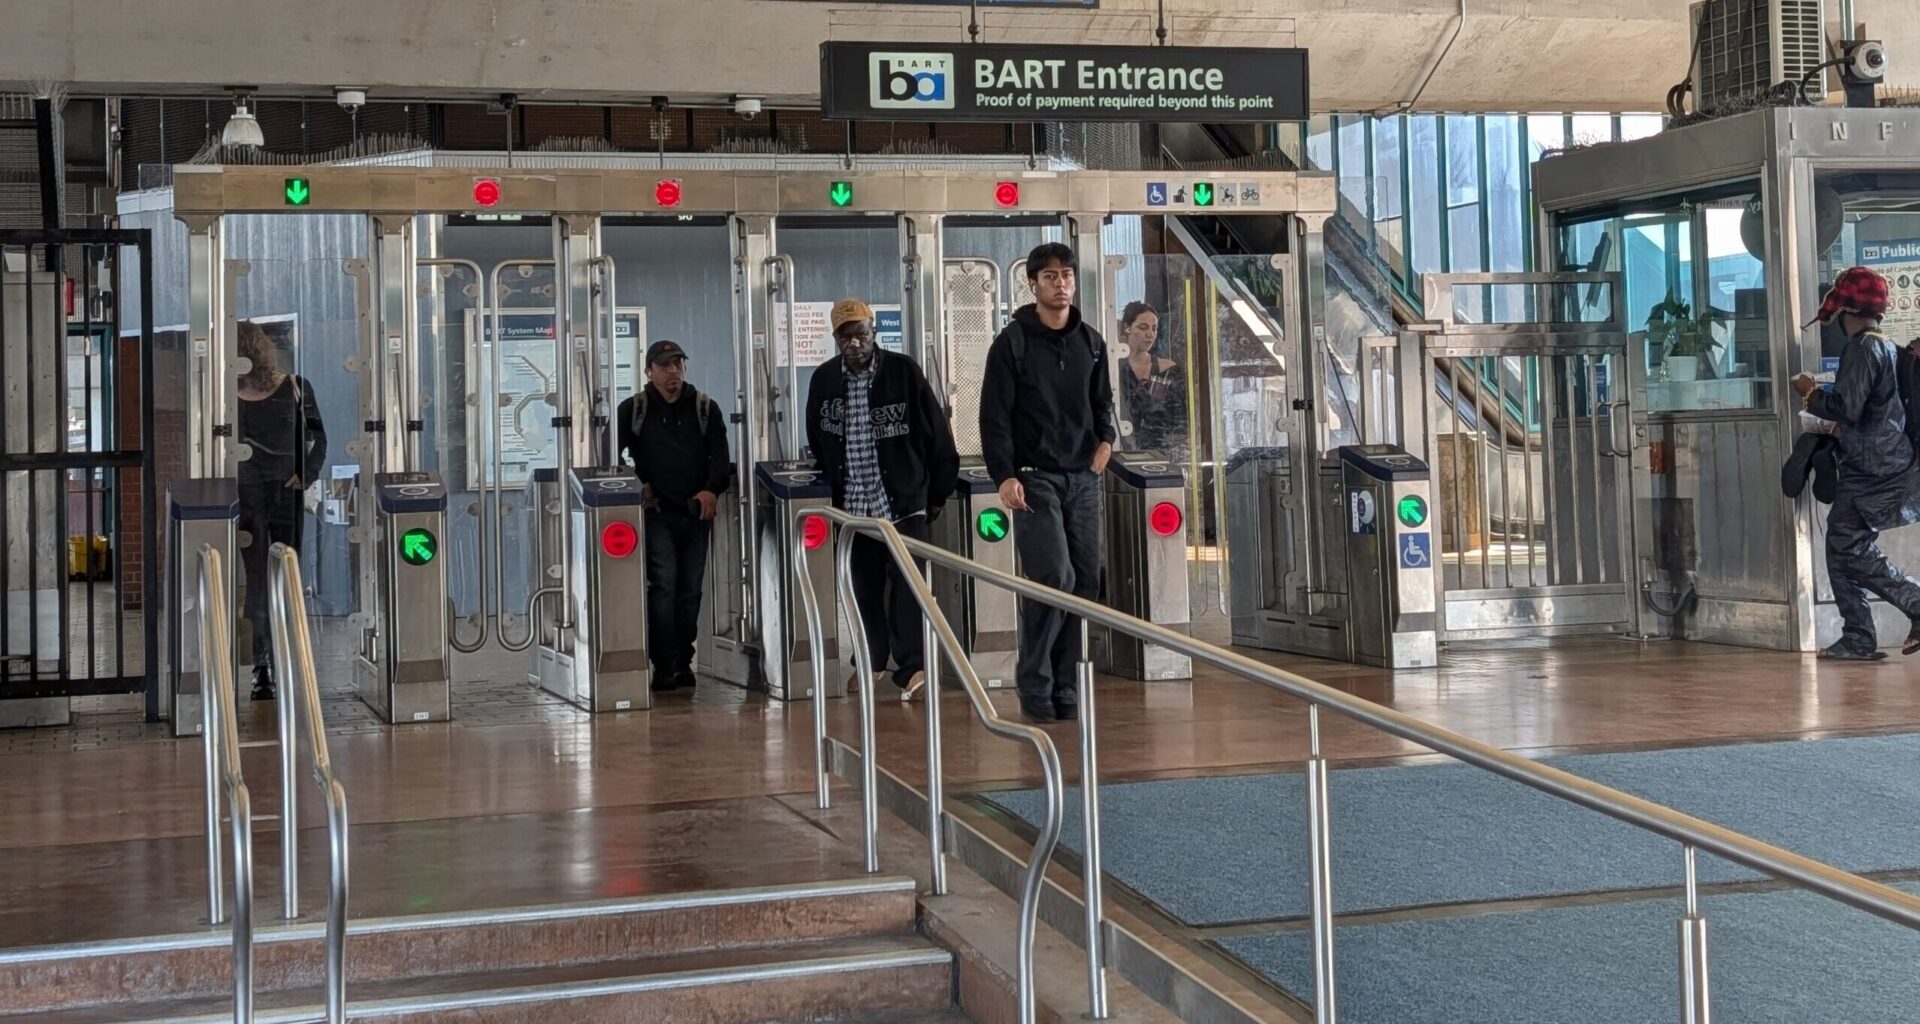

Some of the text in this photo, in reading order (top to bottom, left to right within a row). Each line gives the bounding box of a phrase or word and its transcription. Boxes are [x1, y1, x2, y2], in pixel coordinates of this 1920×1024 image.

[898, 60, 946, 68] BART
[975, 59, 1223, 91] BART Entrance
[976, 93, 1273, 110] Proof of payment required beyond this point
[881, 319, 900, 327] West
[507, 327, 534, 336] System
[535, 326, 553, 336] Map
